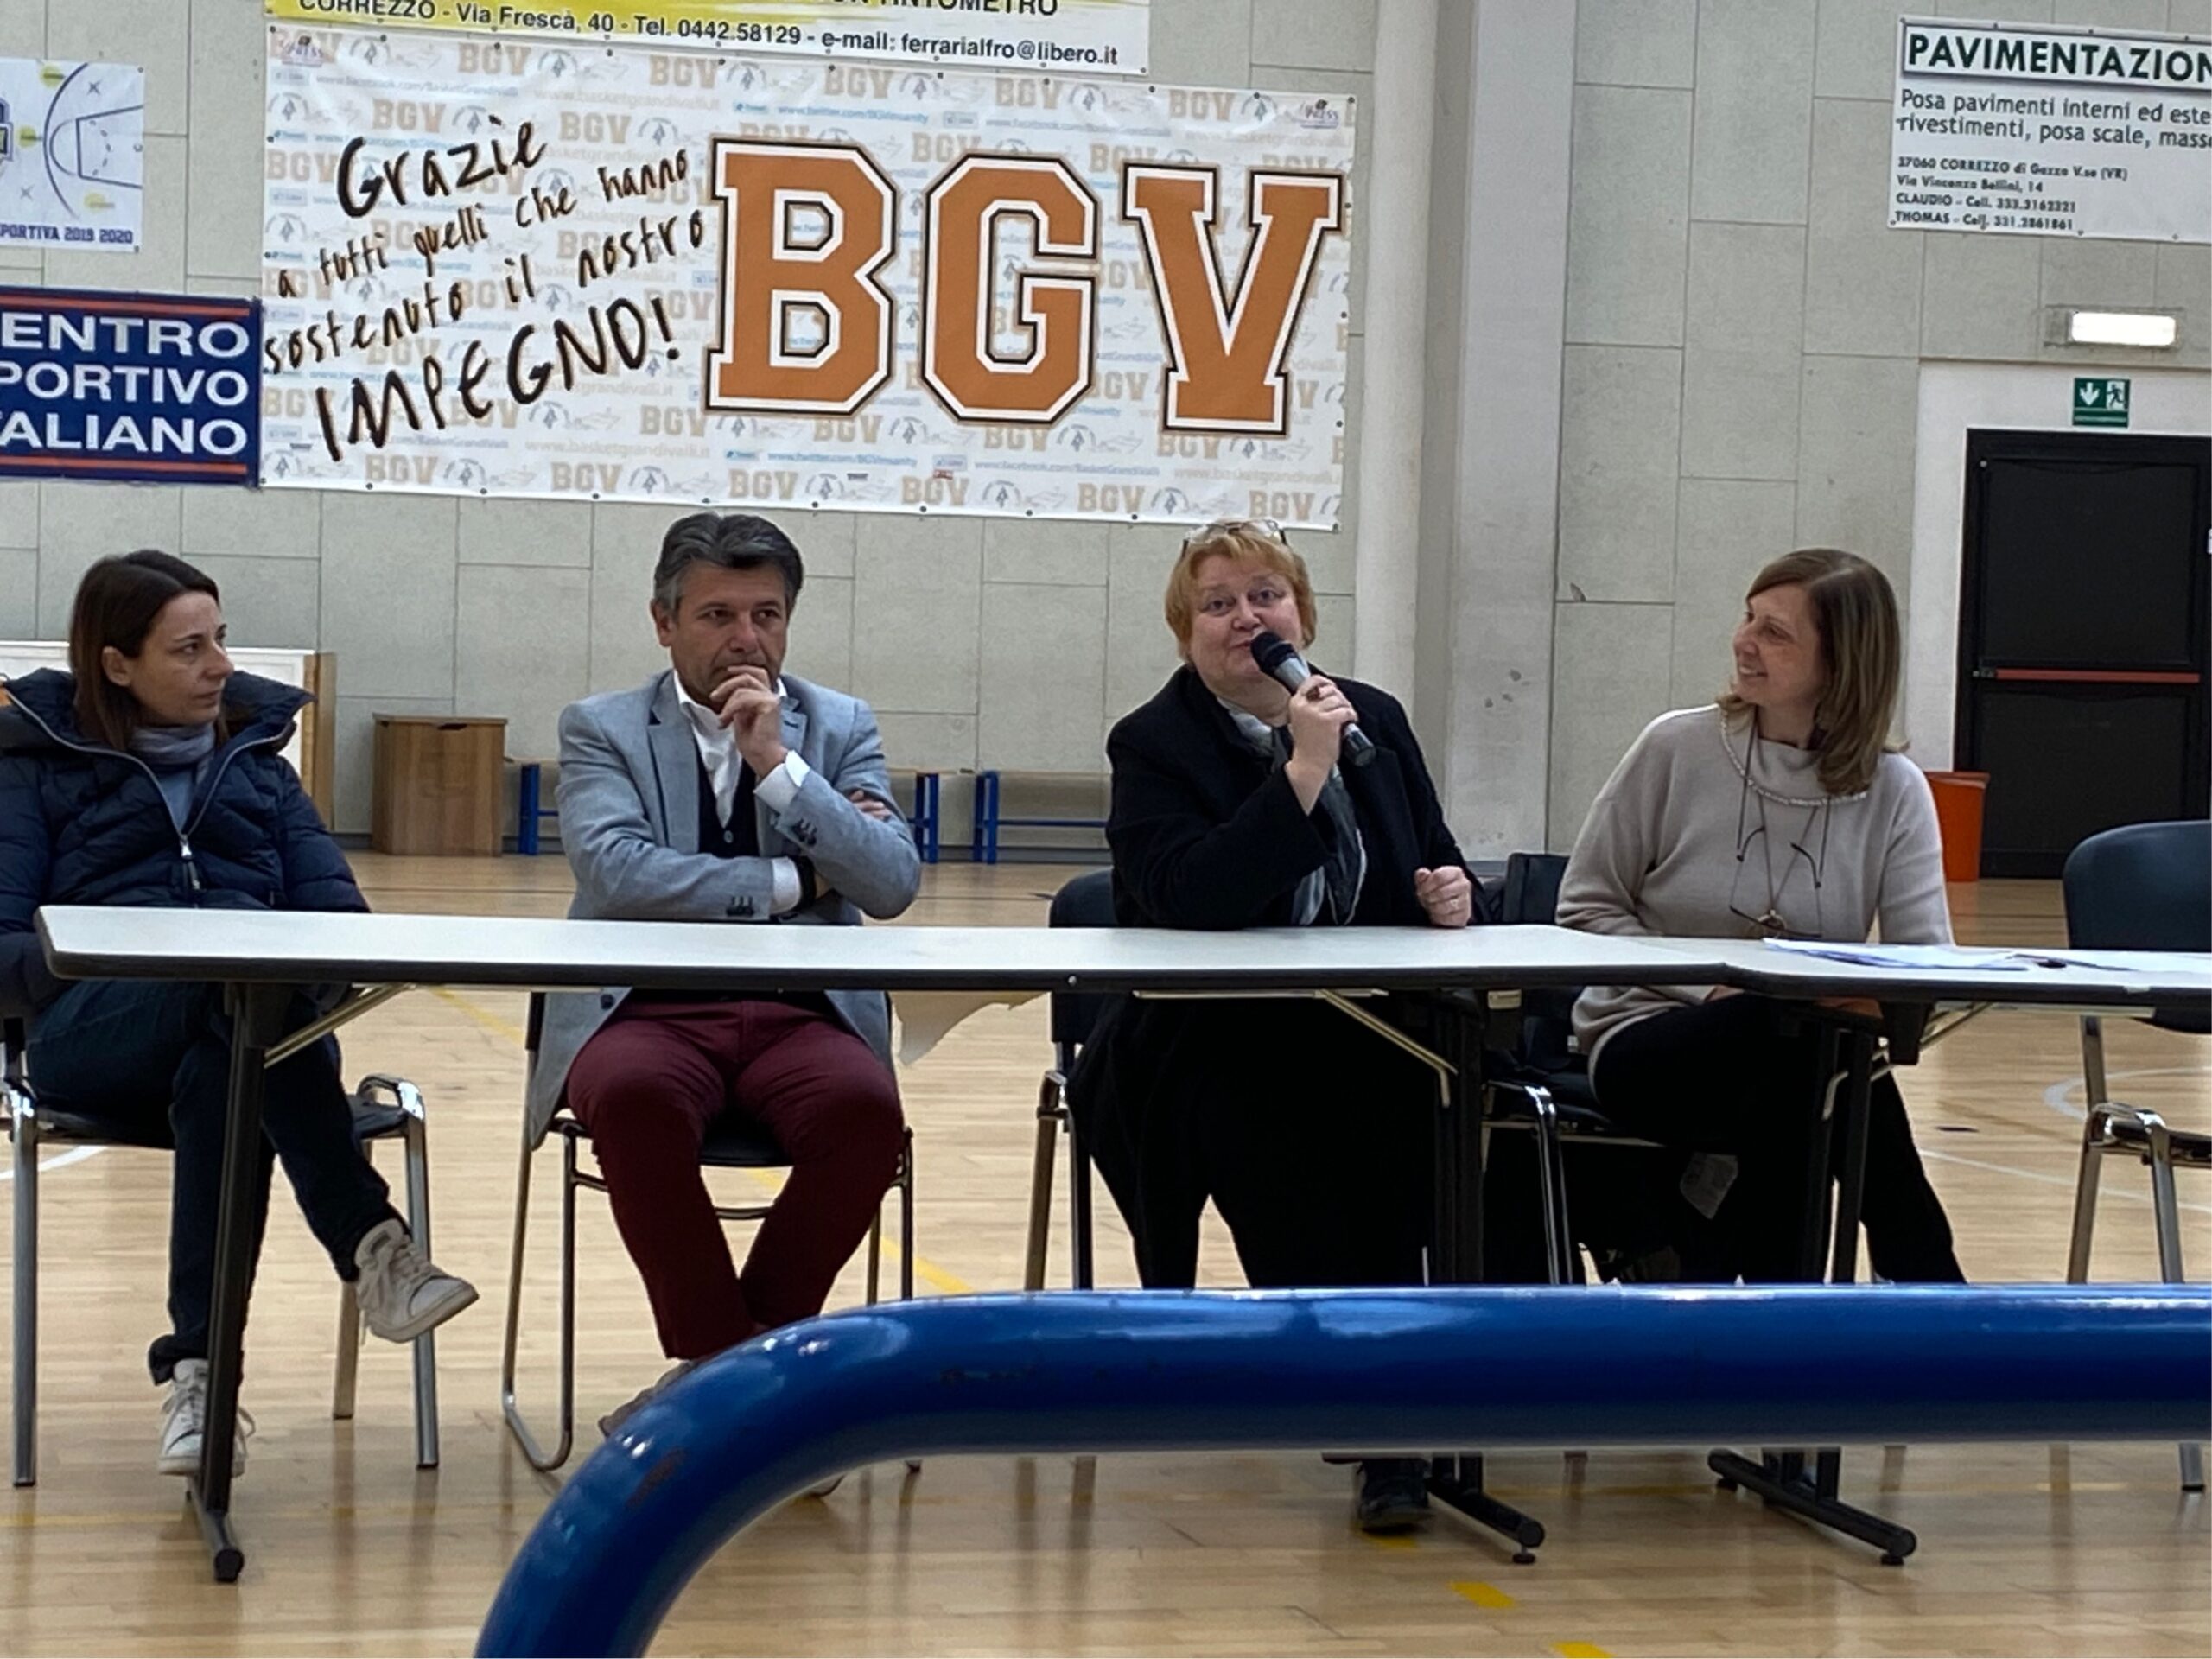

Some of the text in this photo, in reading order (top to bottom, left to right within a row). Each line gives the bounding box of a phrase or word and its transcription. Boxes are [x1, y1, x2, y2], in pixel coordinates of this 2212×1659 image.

[457, 5, 492, 23] Via
[588, 15, 613, 33] 40
[635, 16, 671, 36] Tel.
[677, 19, 801, 44] 0442.58129
[821, 31, 896, 52] e-mail:
[901, 33, 1117, 65] ferrarialfro@libero.it
[458, 43, 531, 75] BGV
[650, 54, 718, 89] BGV
[1908, 33, 2212, 83] PAVIMENTAZION
[824, 67, 893, 99] BGV
[995, 78, 1063, 109] BGV
[372, 99, 447, 133] BGV
[1170, 89, 1236, 122] BGV
[1901, 88, 2211, 125] Posa pavimenti interni ed este
[559, 111, 632, 143] BGV
[1898, 116, 2031, 142] rivestimenti,
[2039, 124, 2084, 144] posa
[2092, 124, 2151, 149] scale,
[337, 114, 548, 218] Grazie
[1897, 175, 1916, 187] Via
[1921, 175, 1978, 189] Vincenzo
[1940, 158, 2010, 174] CORREZZO
[2014, 162, 2026, 174] di
[1896, 192, 1952, 207] CLAUDIO
[278, 269, 297, 298] a
[320, 232, 389, 286] tutti
[414, 203, 489, 278] quelli
[516, 185, 578, 228] che
[597, 149, 688, 202] hanno
[1895, 210, 1950, 225] THOMAS
[99, 229, 133, 245] 2020
[264, 209, 704, 375] sostenuto il nostro
[703, 137, 1344, 435] BGV
[315, 296, 681, 462] IMPEGNO!
[0, 410, 248, 455] ALIANO
[365, 454, 438, 484] BGV
[551, 461, 623, 493] BGV
[728, 468, 799, 500] BGV
[900, 475, 969, 506] BGV
[1078, 482, 1145, 512] BGV
[1249, 490, 1315, 519] BGV
